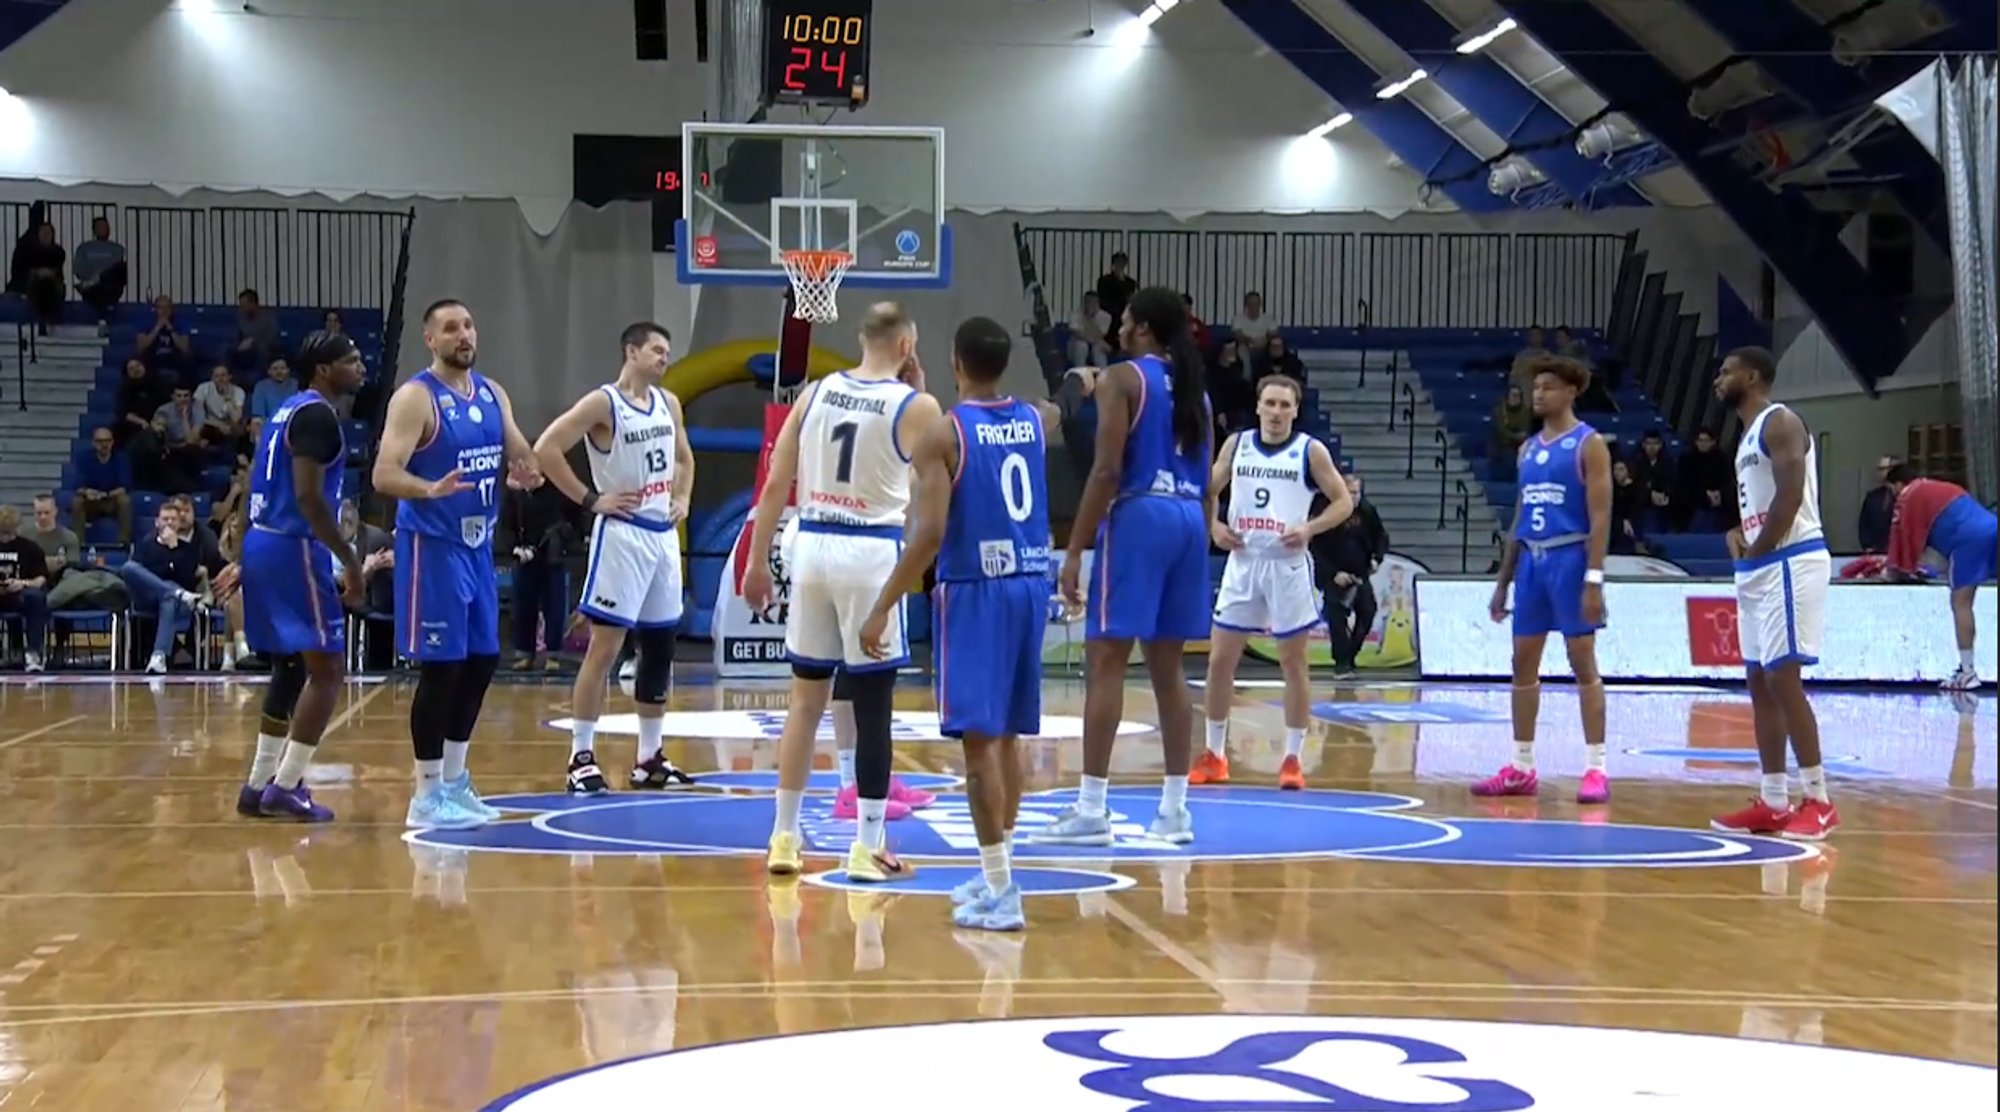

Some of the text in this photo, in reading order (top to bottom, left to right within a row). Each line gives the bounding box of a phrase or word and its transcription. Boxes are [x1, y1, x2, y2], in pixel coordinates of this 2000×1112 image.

[783, 14, 862, 44] 10:00
[784, 47, 847, 89] 24
[823, 390, 886, 416] ROSENTHAL
[265, 429, 279, 481] 1
[646, 448, 668, 474] 13
[830, 421, 859, 484] 1
[478, 477, 498, 507] 17
[1000, 453, 1033, 522] 0
[1254, 487, 1271, 509] 9
[1531, 506, 1546, 532] 5
[732, 641, 787, 660] GET BU
